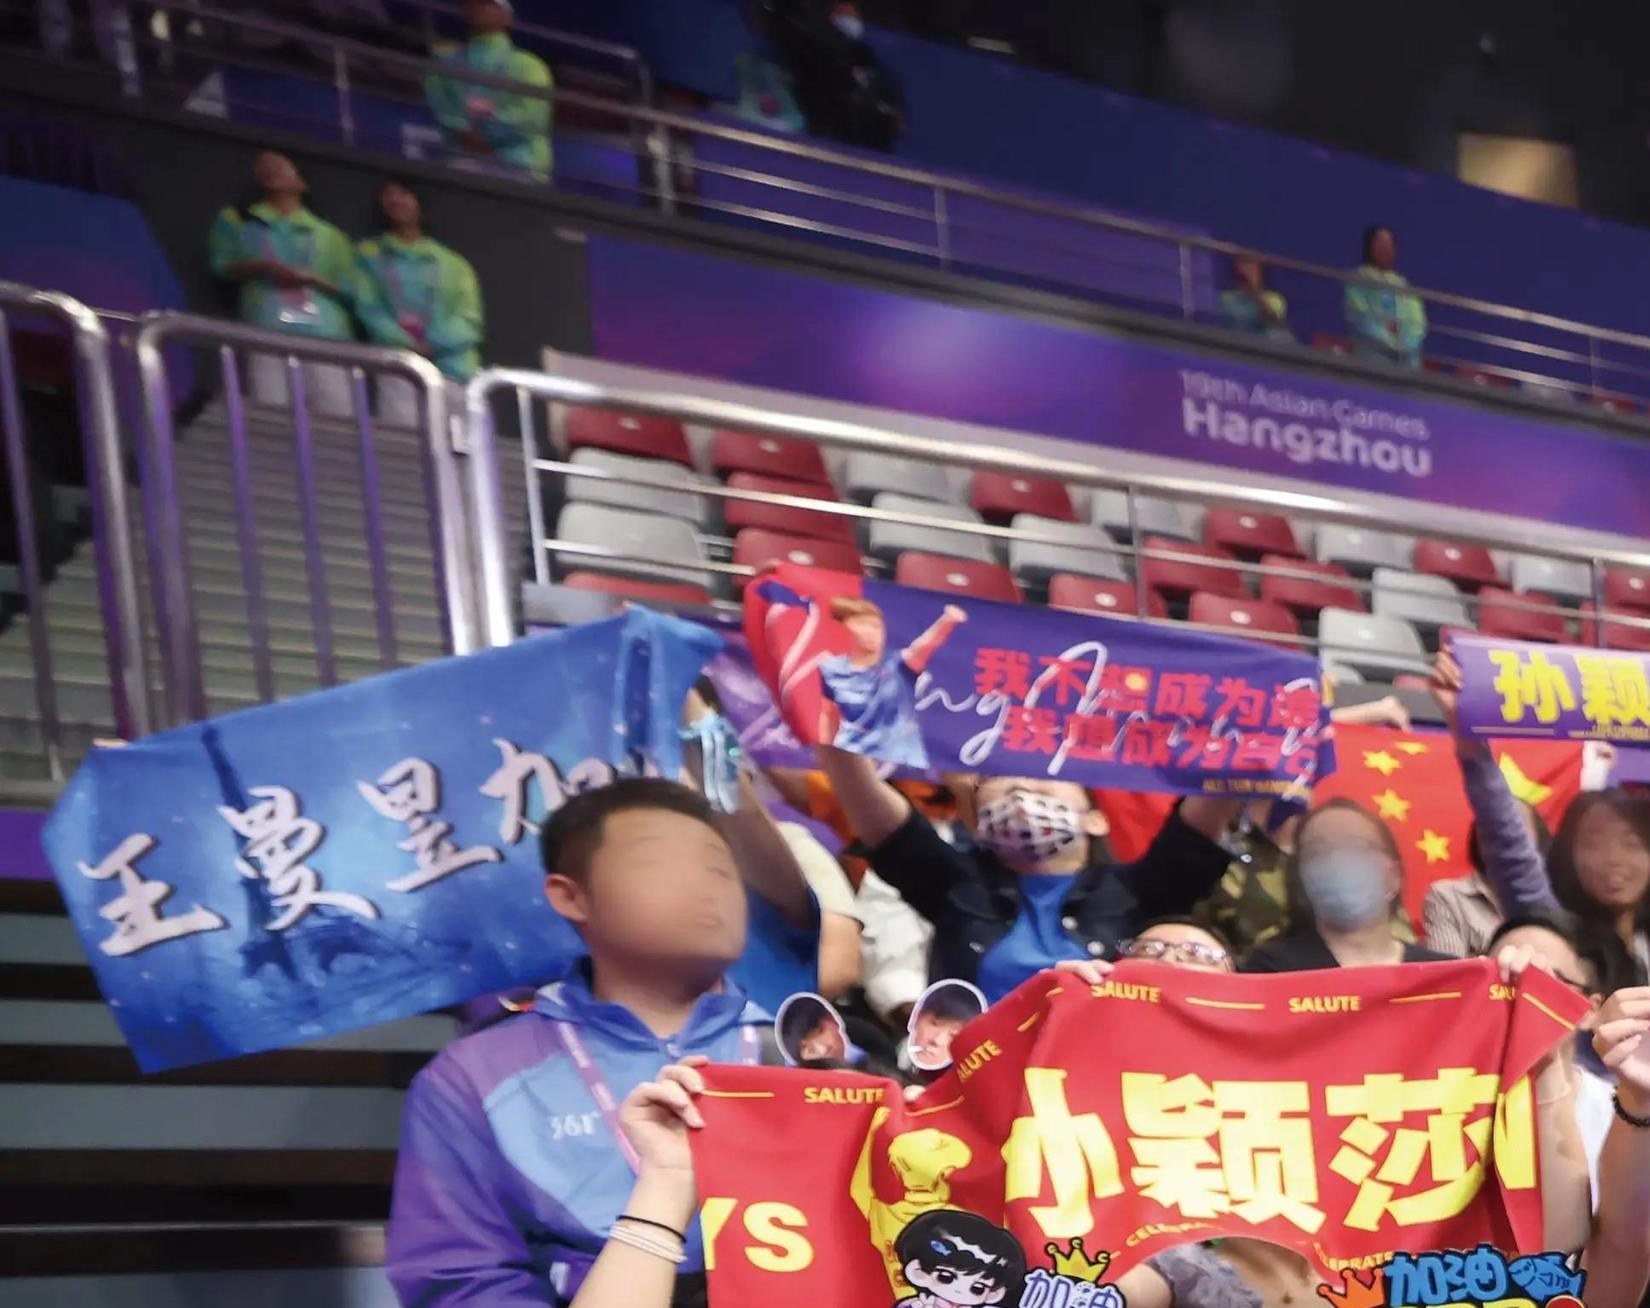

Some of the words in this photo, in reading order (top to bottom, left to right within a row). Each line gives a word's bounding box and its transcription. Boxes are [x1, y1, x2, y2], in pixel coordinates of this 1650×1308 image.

[1182, 397, 1434, 478] Hangzhou
[1250, 384, 1330, 419] Asian
[1333, 400, 1431, 440] Games
[74, 725, 640, 957] 王曼昱加
[1092, 982, 1160, 1004] SALUTE
[1288, 994, 1361, 1013] SALUTE
[1384, 1245, 1508, 1306] 加油
